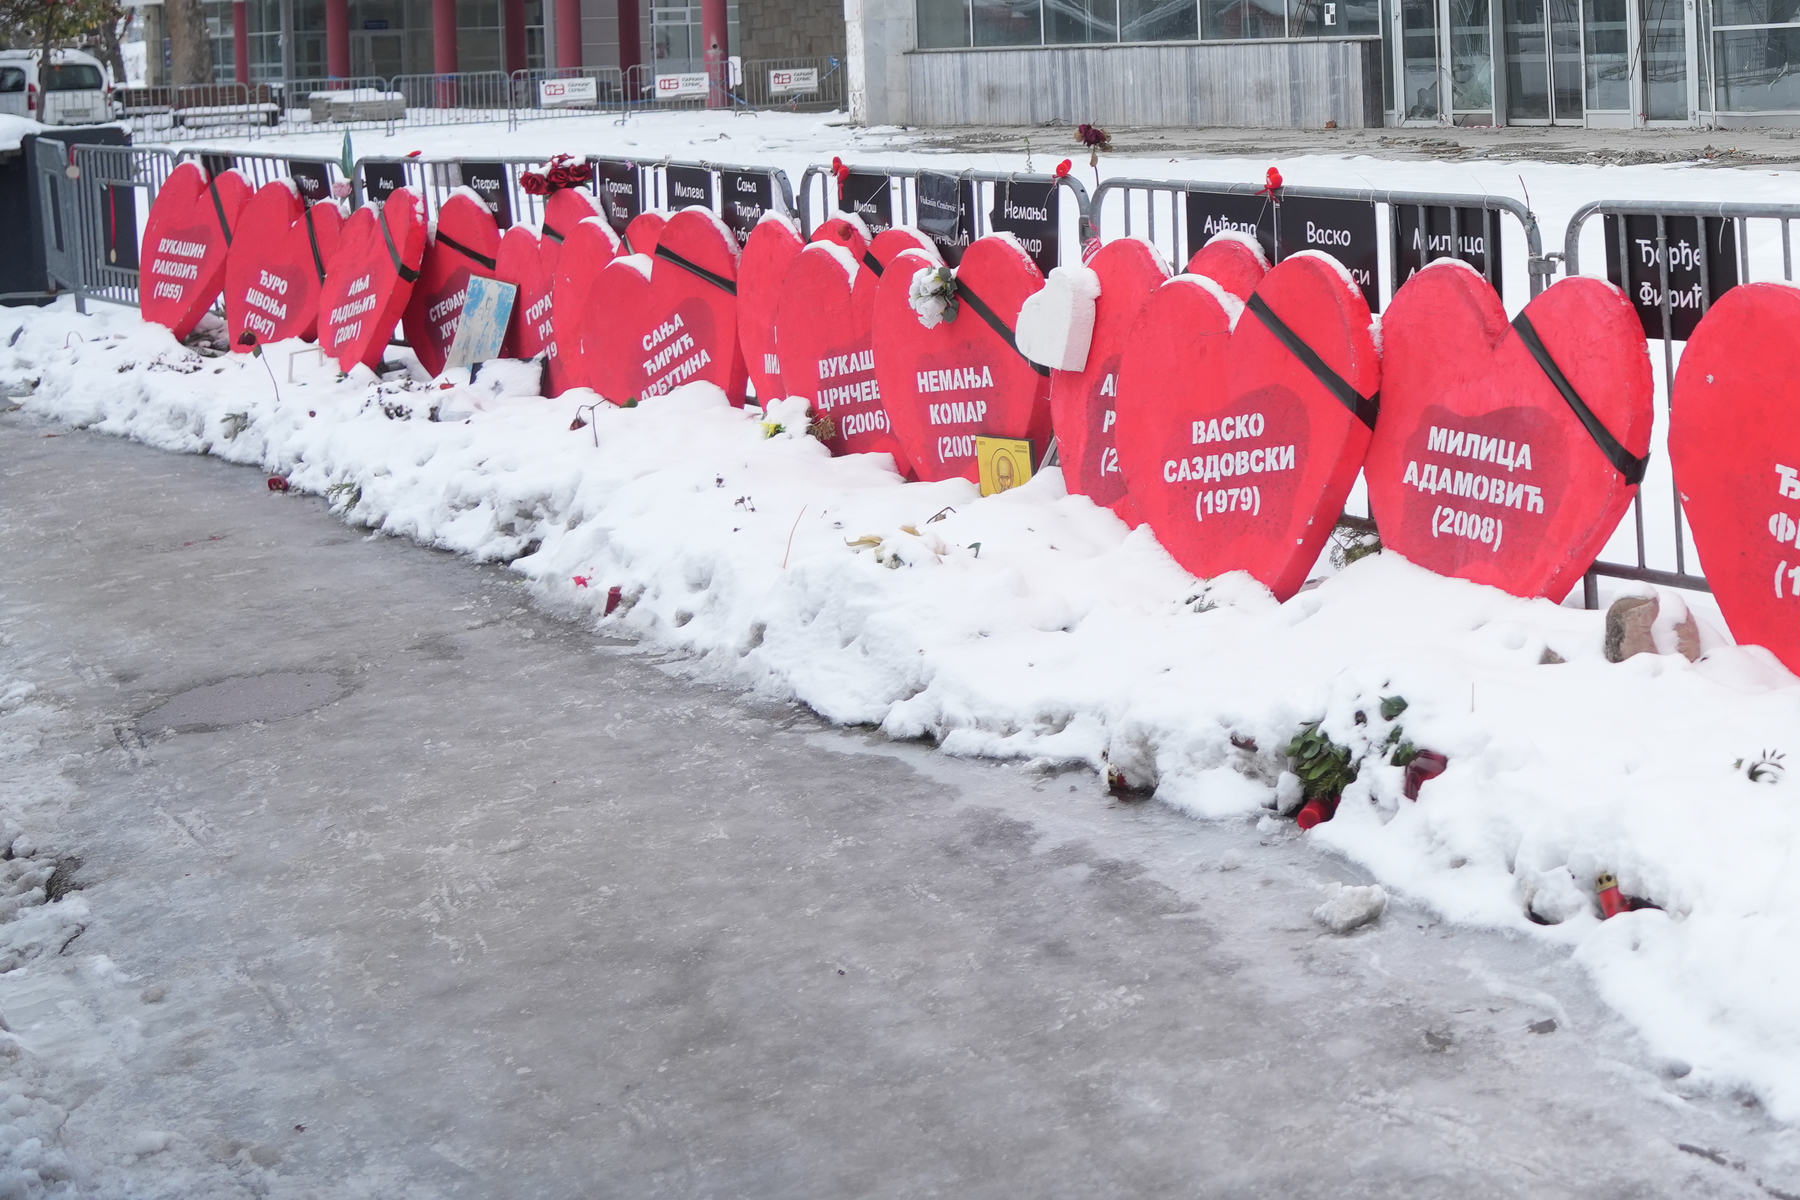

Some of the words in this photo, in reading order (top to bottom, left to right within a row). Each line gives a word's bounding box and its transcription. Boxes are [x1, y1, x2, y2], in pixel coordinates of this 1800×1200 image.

[471, 176, 500, 193] Стефан
[605, 178, 633, 195] Горанка
[675, 181, 704, 199] Милева
[736, 176, 757, 193] Сања
[612, 202, 628, 218] Раца
[734, 200, 761, 221] Ћирић
[1004, 200, 1047, 221] Немања
[1306, 220, 1351, 247] Васко
[158, 238, 207, 259] ВУКАШИН
[152, 259, 198, 280] РАКОВИЋ
[260, 269, 288, 295] ЂУРО
[154, 281, 184, 303] (1955)
[347, 273, 371, 297] АЊА
[246, 287, 288, 320] ШВОЊА
[329, 293, 377, 325] РАДОЊИЋ
[429, 288, 466, 322] СТЕФАН
[525, 290, 553, 326] ГОРА
[244, 311, 276, 340] (1947)
[334, 320, 362, 348] (2001)
[440, 314, 463, 340] ХРК
[642, 313, 684, 352] САЊА
[642, 333, 695, 377] ЋИРИЋ
[818, 349, 875, 380] ВУКАШ
[640, 348, 712, 402] АРБУТИНА
[917, 365, 994, 393] НЕМАЊА
[842, 408, 890, 441] (2006)
[929, 401, 987, 425] КОМАР
[1192, 412, 1264, 445] ВАСКО
[937, 435, 979, 464] (2007
[1427, 425, 1532, 471] МИЛИЦА
[1163, 444, 1296, 484] САЗДОВСКИ
[1402, 460, 1545, 514] АДАМОВИЋ
[1195, 486, 1261, 522] (1979)
[1431, 505, 1504, 553] (2008)
